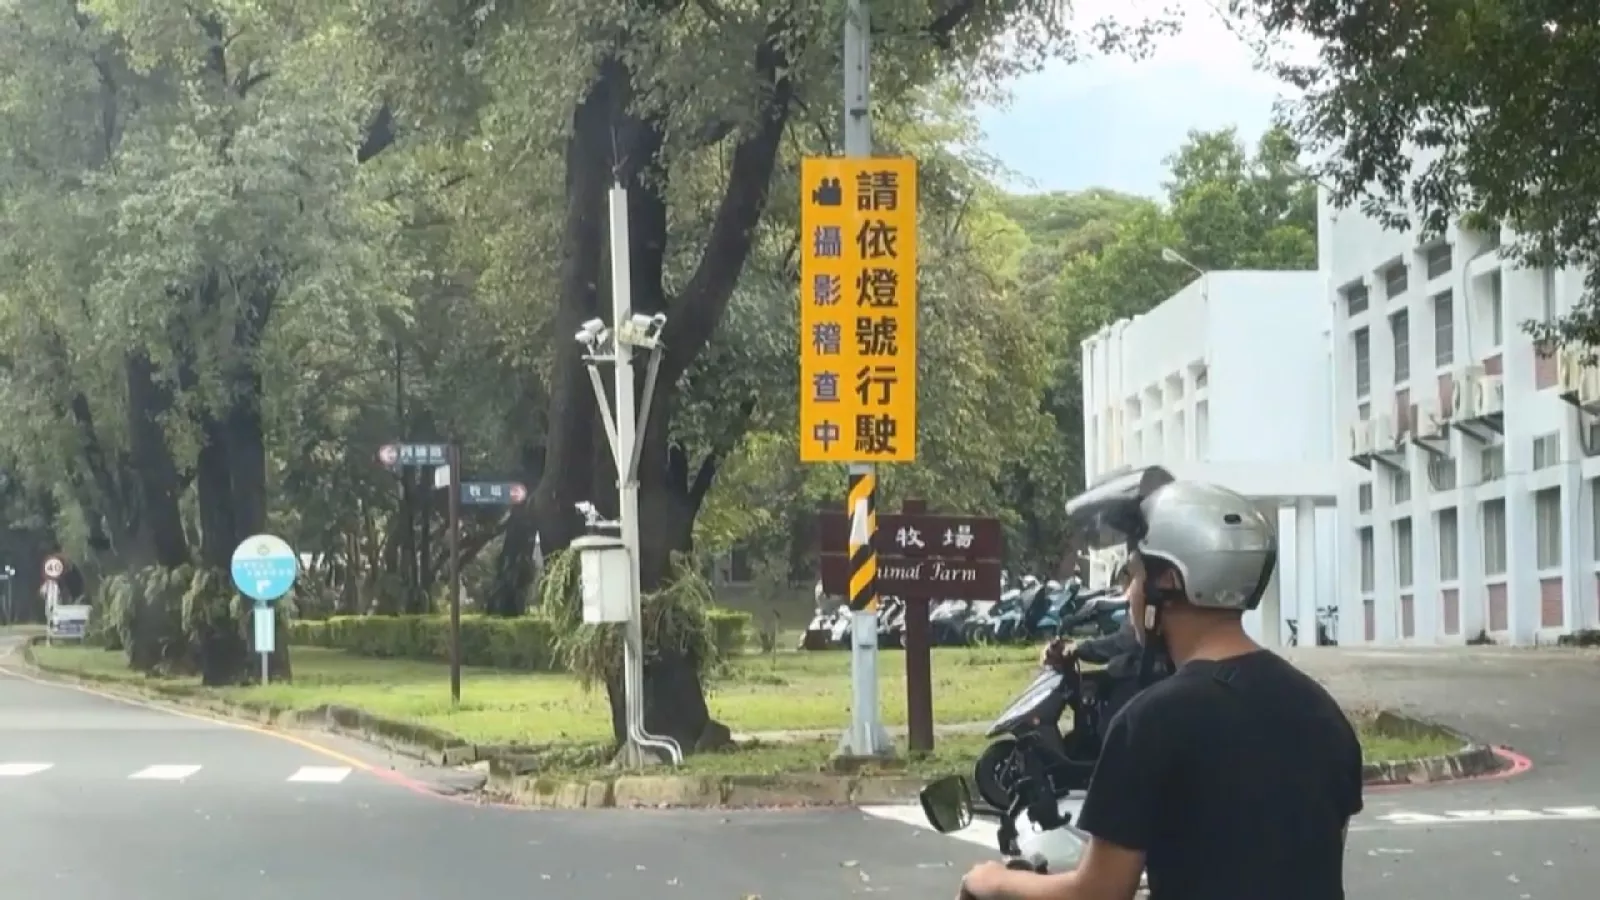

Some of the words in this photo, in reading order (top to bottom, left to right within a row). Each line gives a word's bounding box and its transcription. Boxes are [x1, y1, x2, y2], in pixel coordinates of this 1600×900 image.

[812, 225, 842, 453] 攝影稽查中
[855, 170, 899, 455] 請依燈號行駛
[895, 524, 974, 549] 牧場
[929, 562, 976, 581] Farm
